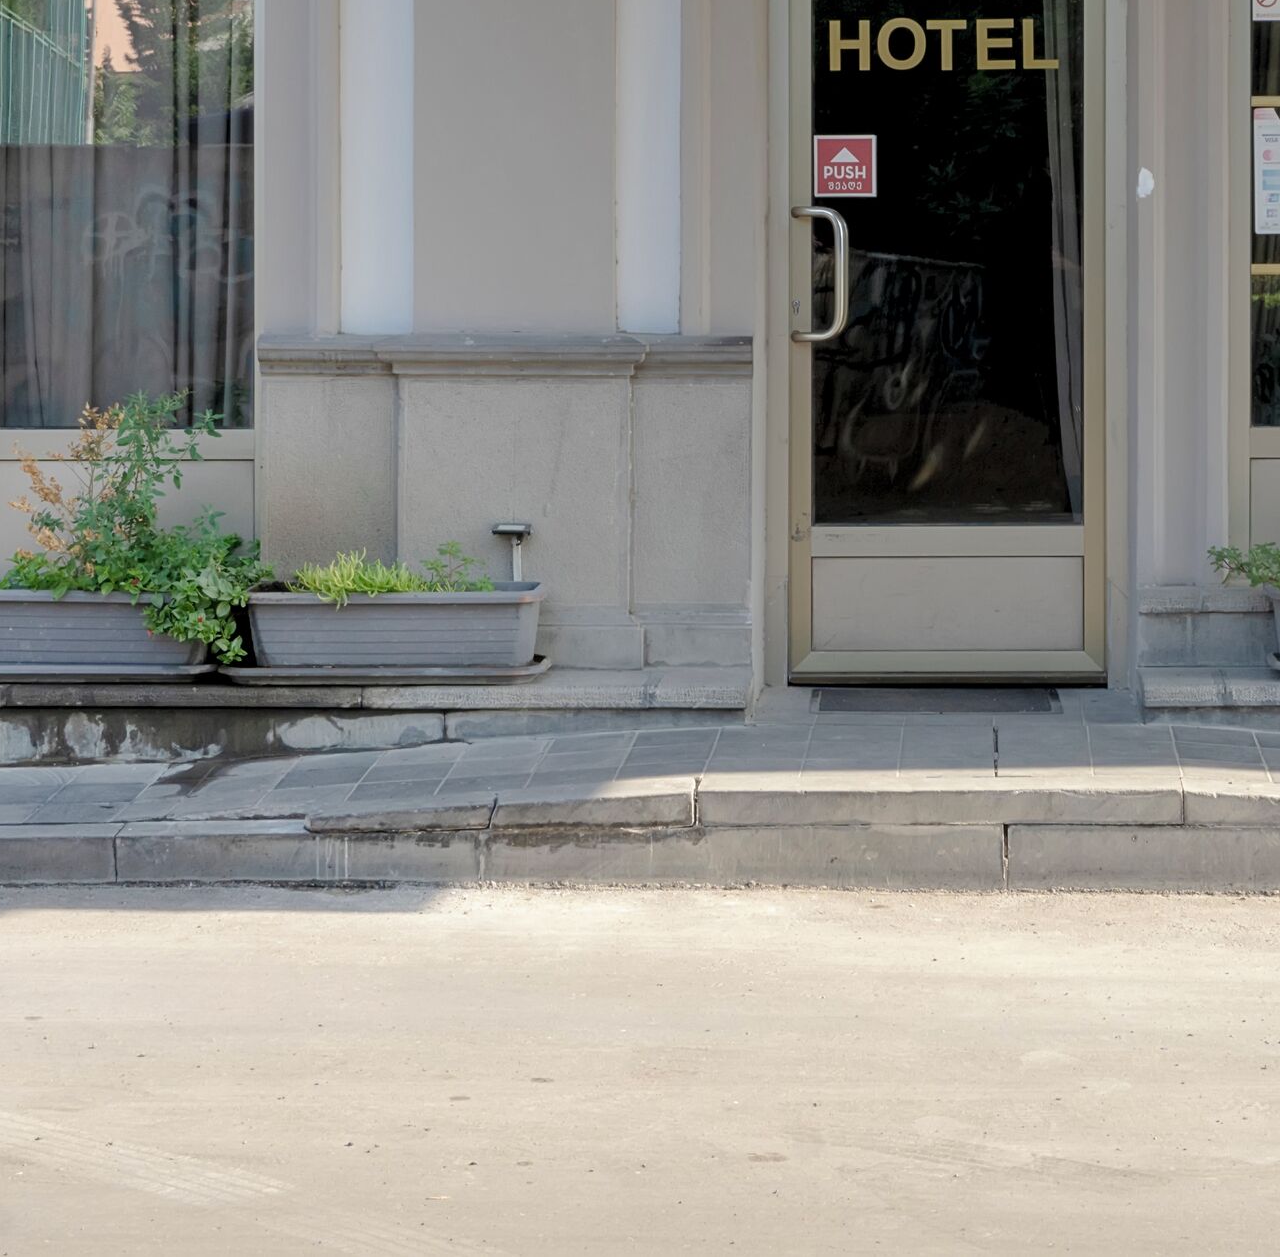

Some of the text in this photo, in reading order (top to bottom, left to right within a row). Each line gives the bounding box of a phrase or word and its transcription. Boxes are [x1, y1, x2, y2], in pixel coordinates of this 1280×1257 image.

[828, 17, 1060, 72] HOTEL
[823, 165, 867, 179] PUSH
[827, 181, 862, 190] შეაღე
